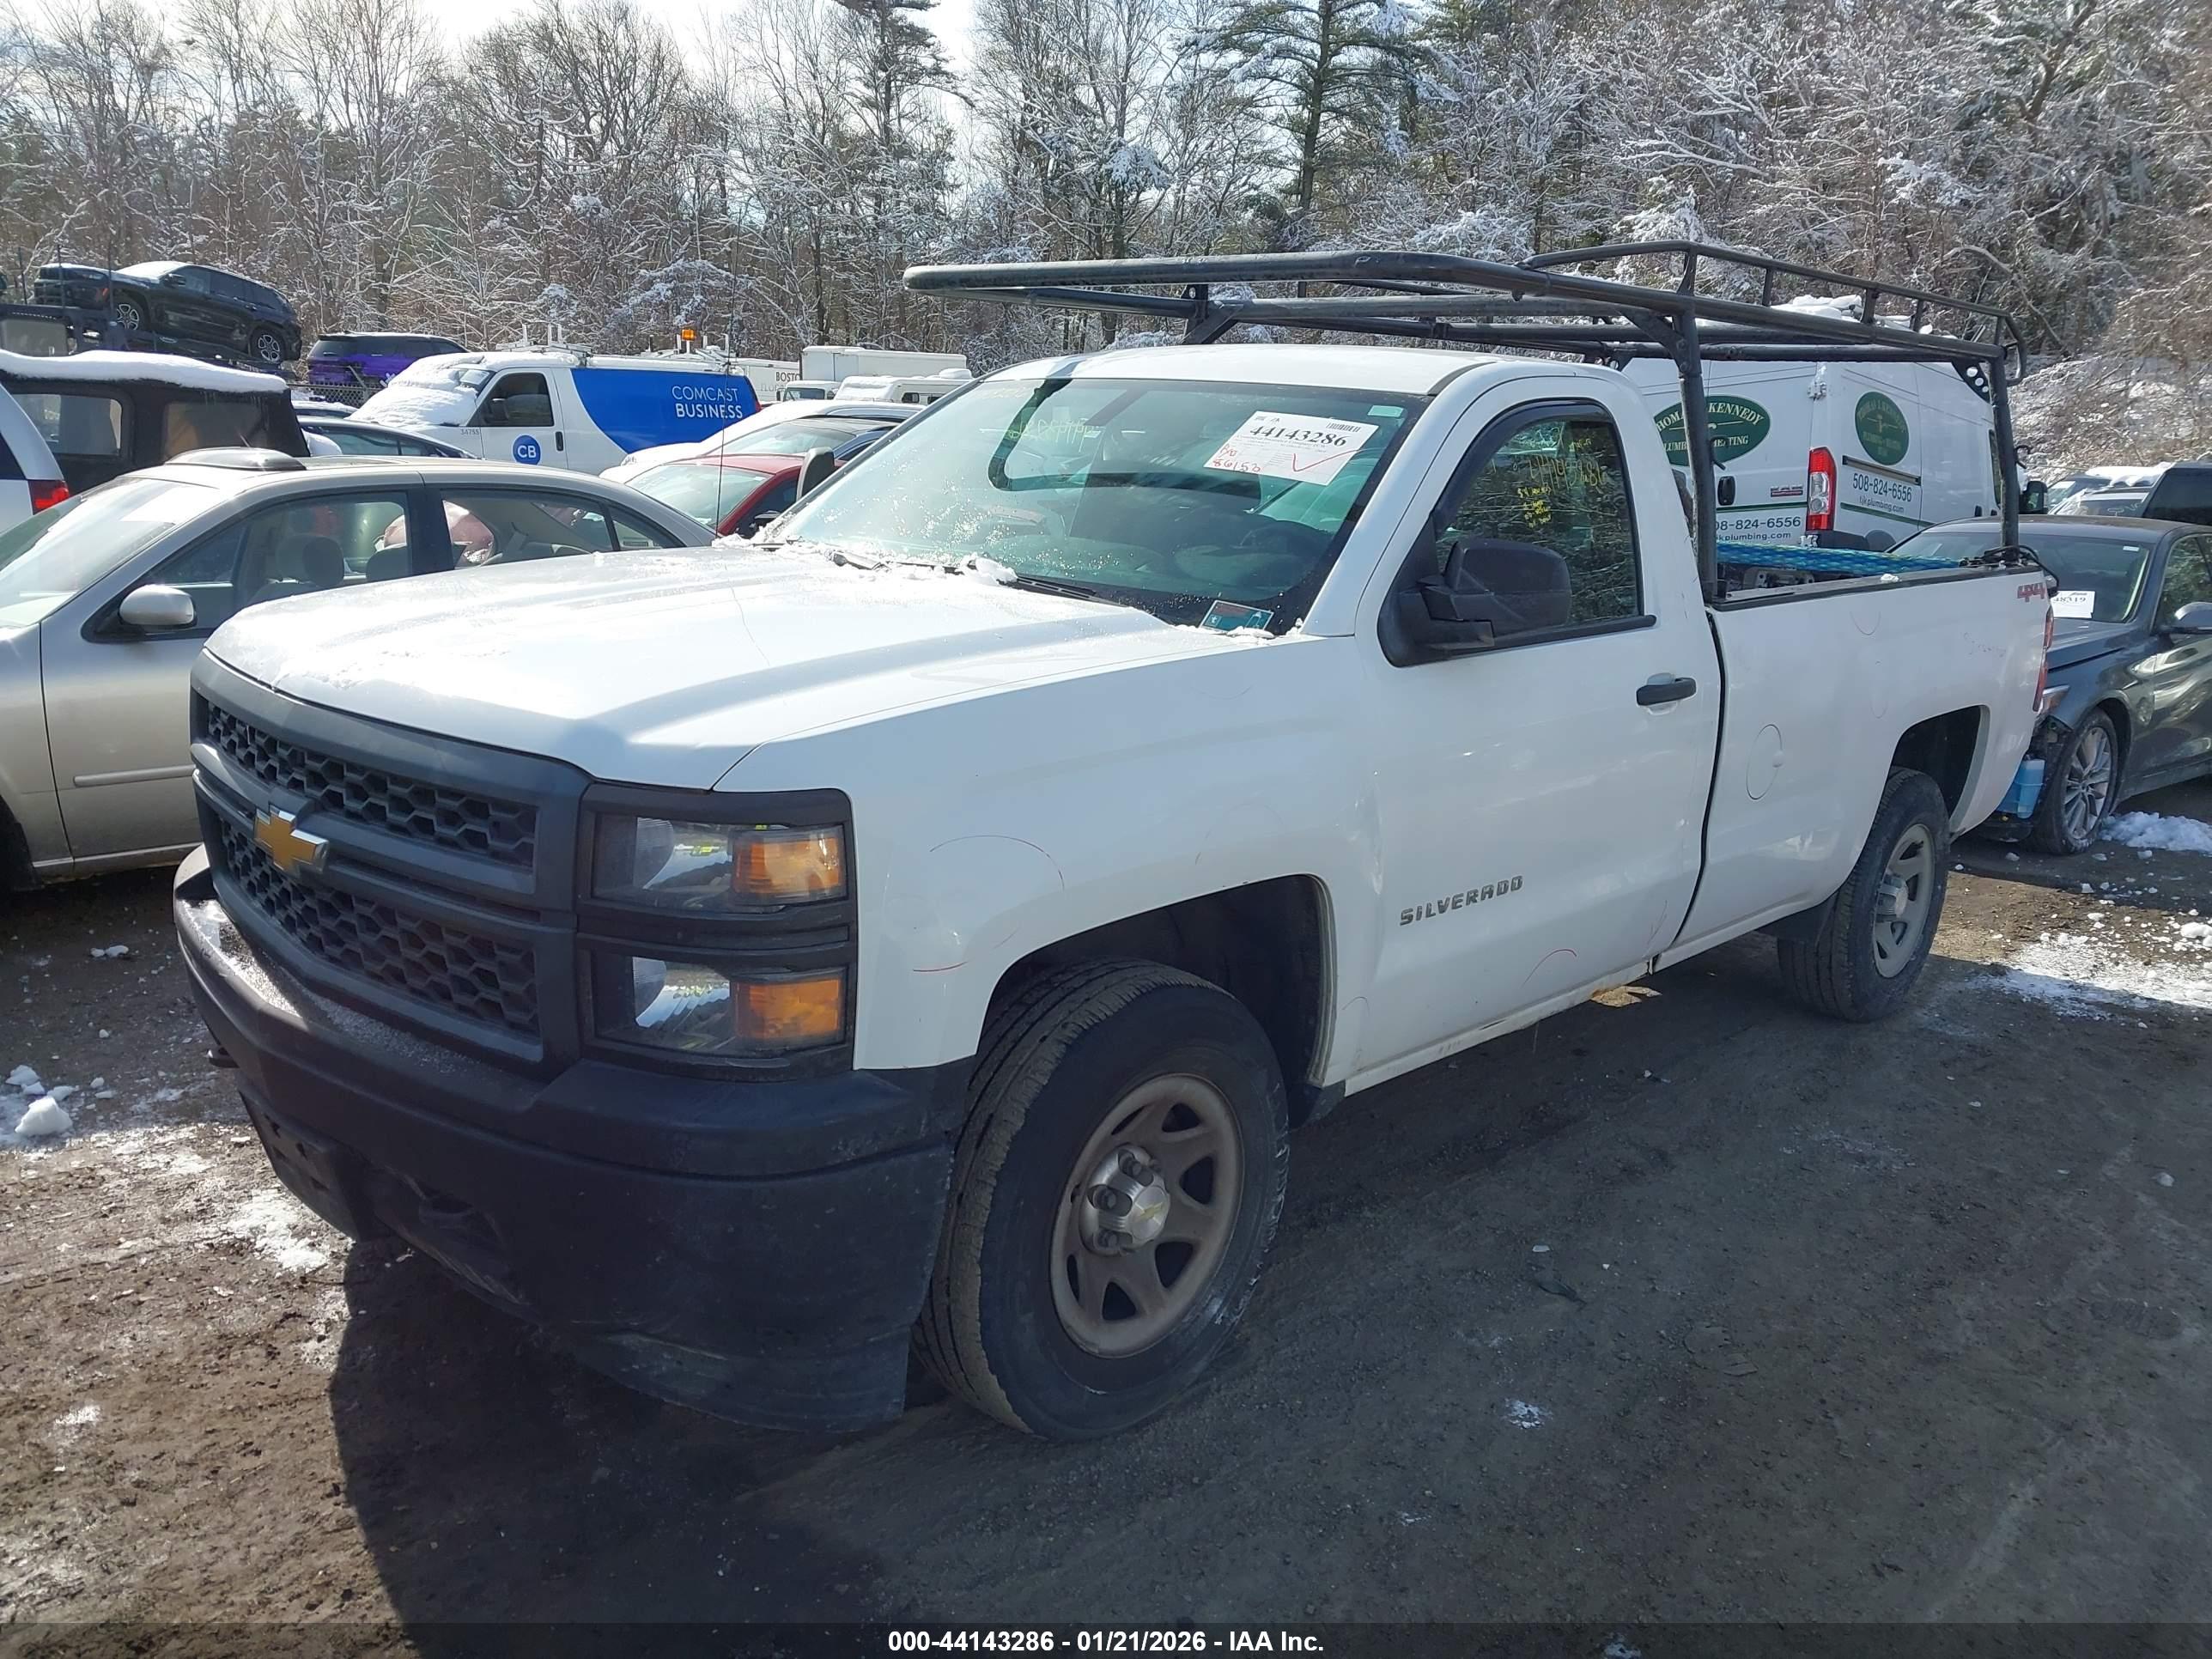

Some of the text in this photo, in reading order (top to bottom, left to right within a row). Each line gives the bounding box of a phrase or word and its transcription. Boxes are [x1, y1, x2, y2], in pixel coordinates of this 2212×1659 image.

[775, 371, 800, 382] BOSTO
[672, 385, 738, 403] COMCAST
[675, 403, 744, 419] BUSINESS
[1707, 401, 1765, 426] KENNEDY
[1249, 425, 1349, 447] 44143286
[517, 445, 537, 459] CB
[1852, 472, 1913, 502] 508-824-6556
[1716, 515, 1802, 532] 08-824-6556
[1400, 875, 1522, 927] SILVERADO
